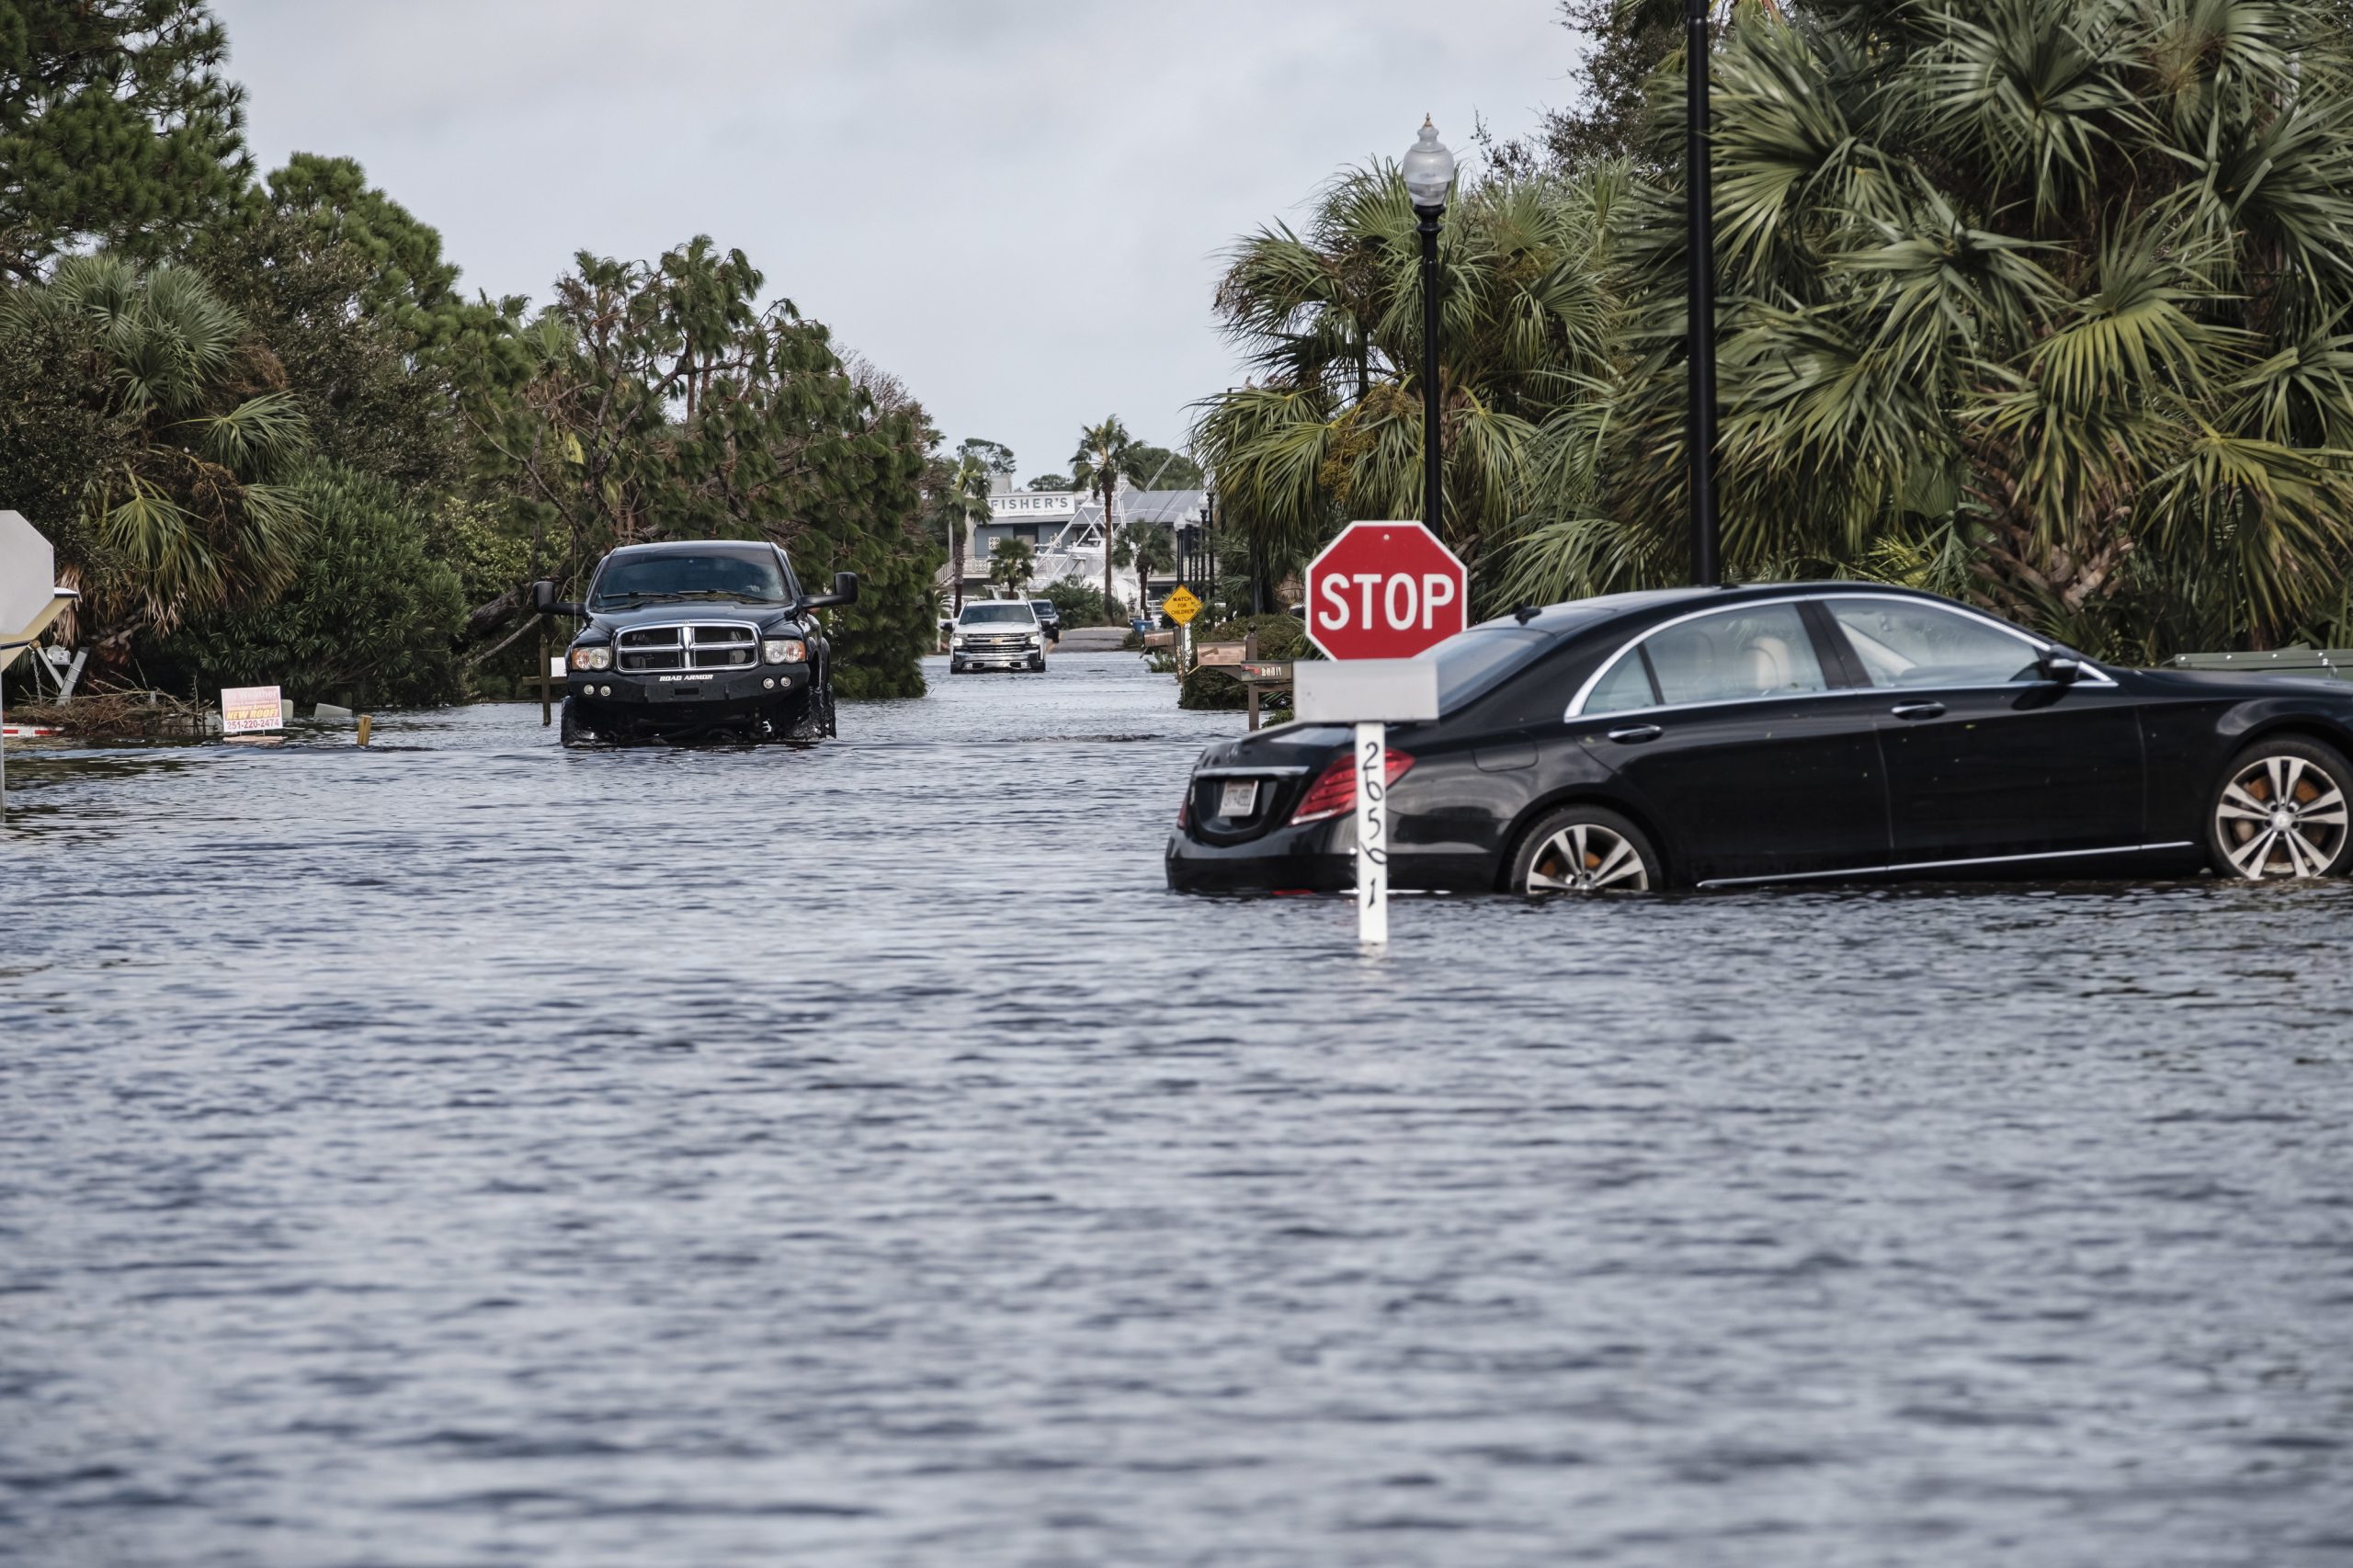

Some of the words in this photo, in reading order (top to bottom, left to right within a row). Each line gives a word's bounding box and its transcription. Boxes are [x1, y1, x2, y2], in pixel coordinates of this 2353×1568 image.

[991, 497, 1068, 509] FISHER'S
[1319, 573, 1454, 631] STOP
[227, 711, 248, 720] NEW
[250, 709, 278, 718] ROOF!
[227, 719, 279, 730] 251-220-2474
[1359, 741, 1387, 909] 26561
